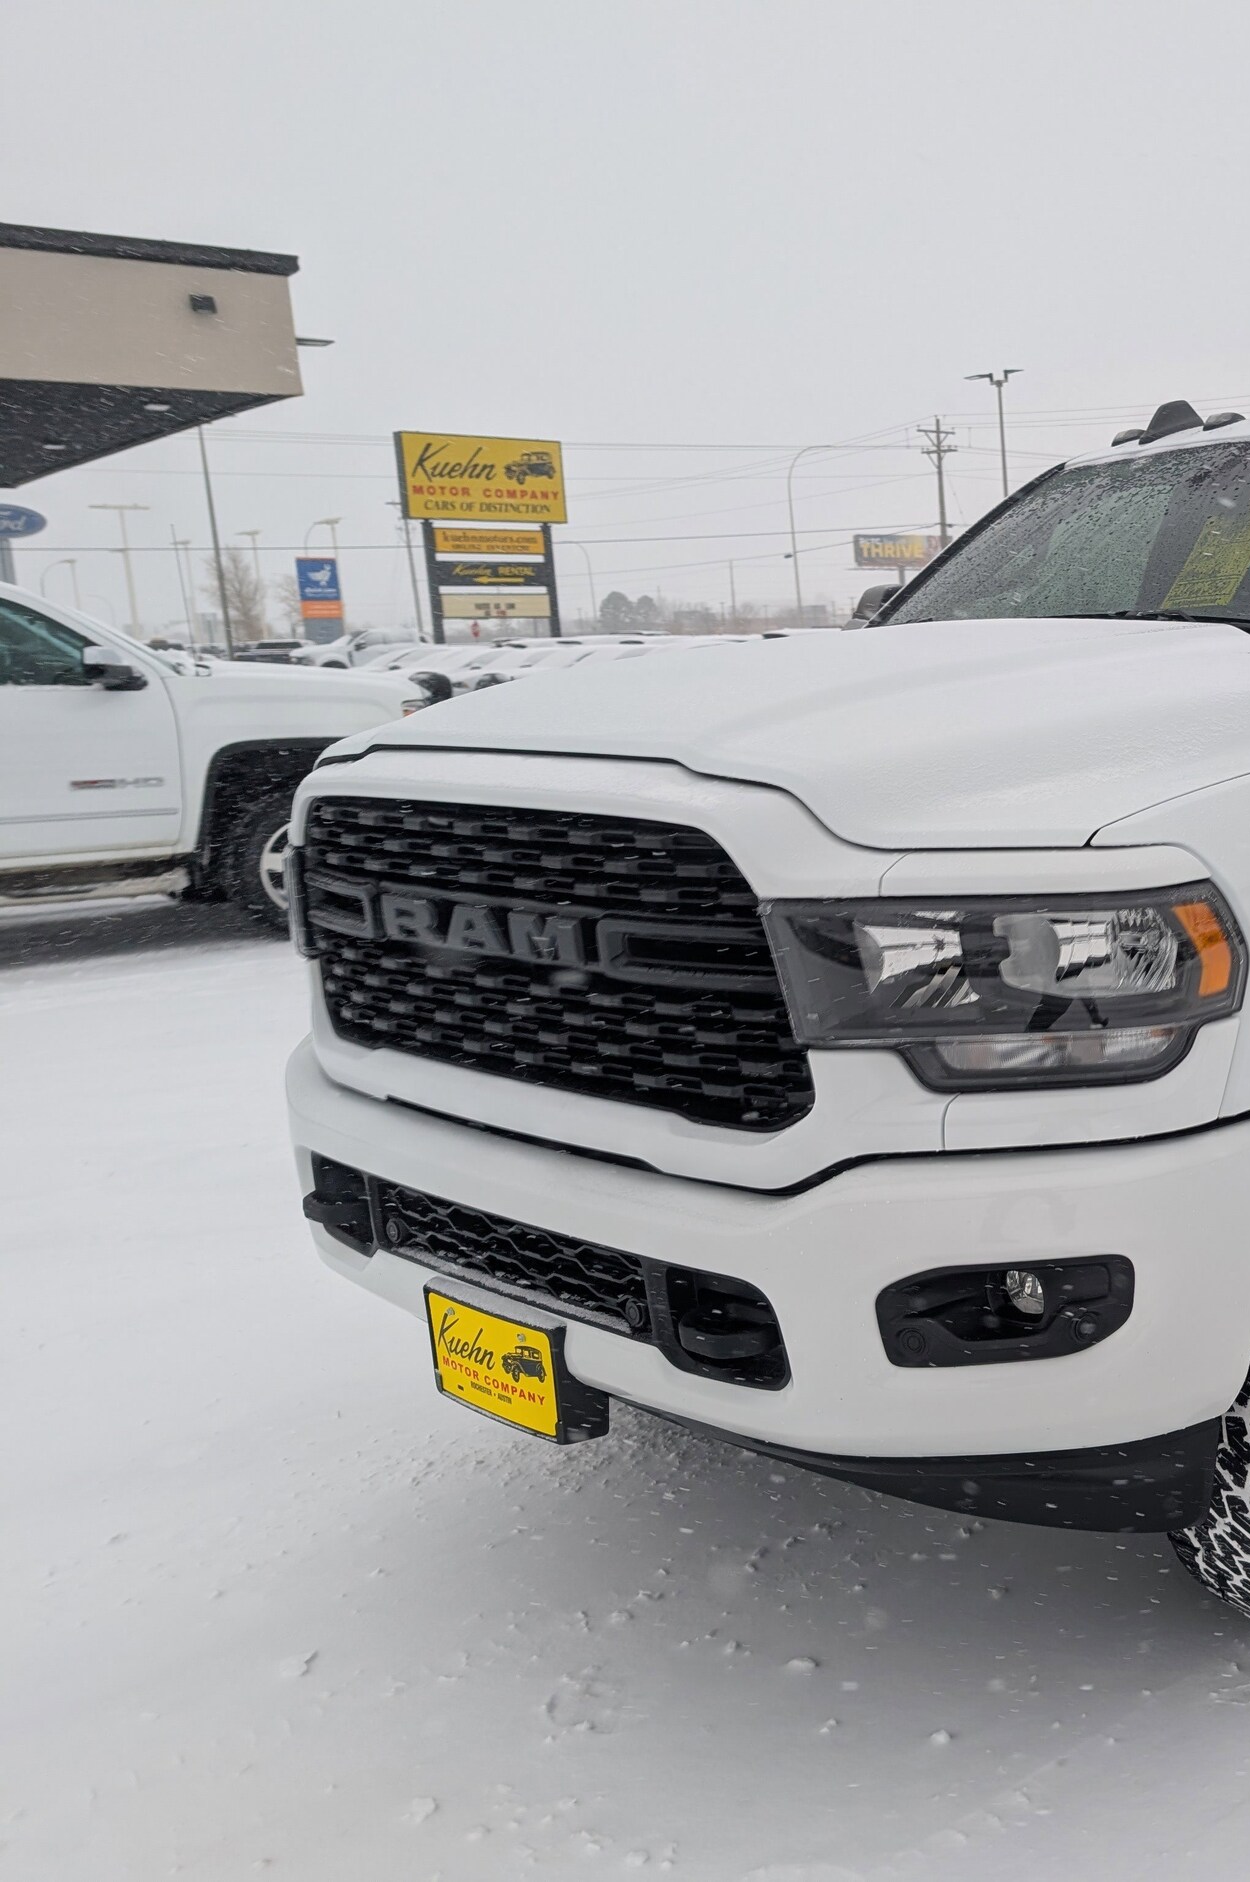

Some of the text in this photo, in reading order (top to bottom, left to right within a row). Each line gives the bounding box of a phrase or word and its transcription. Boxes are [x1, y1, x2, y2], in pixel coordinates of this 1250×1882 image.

[411, 443, 498, 482] Kuehn
[411, 485, 561, 501] MOTOR COMPANY
[423, 500, 551, 514] CARS OF DISTINCTION
[442, 531, 539, 545] kuehnmotors.com
[860, 542, 925, 559] THRIVE
[380, 892, 588, 967] RAM
[437, 1312, 496, 1371] Kuehn
[442, 1355, 546, 1406] MOTOR COMPANY
